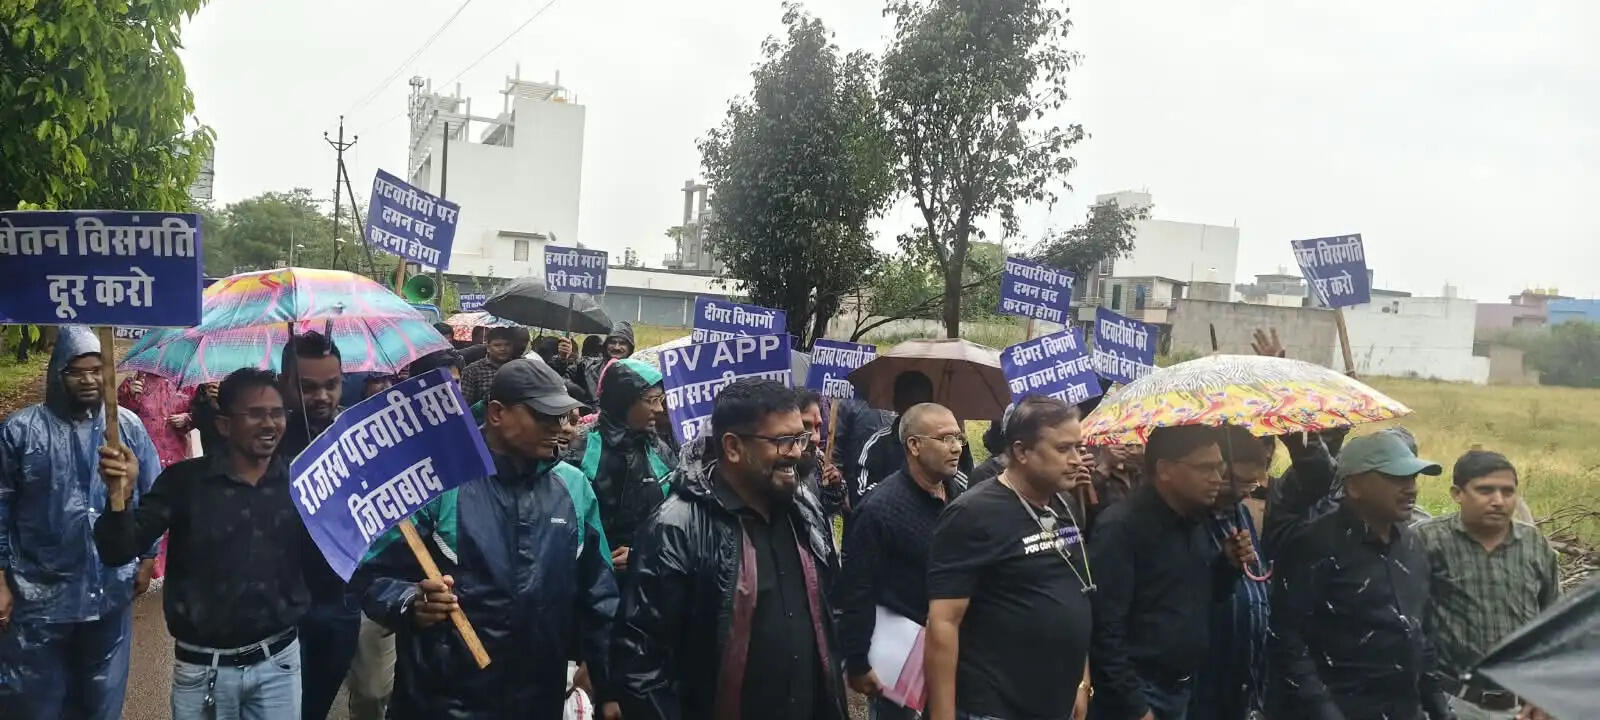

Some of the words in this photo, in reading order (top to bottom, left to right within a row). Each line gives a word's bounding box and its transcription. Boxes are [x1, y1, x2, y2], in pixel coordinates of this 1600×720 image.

[375, 177, 437, 217] पटवारीयों
[437, 204, 457, 224] पर
[75, 216, 197, 257] विसंगति
[382, 205, 414, 232] दमन
[415, 218, 436, 240] बंद
[371, 225, 408, 254] करना
[408, 238, 441, 265] होगा
[545, 250, 579, 267] हमारी
[1317, 236, 1363, 266] विसंगति
[548, 270, 567, 290] पूरी
[569, 272, 594, 289] करो
[1006, 261, 1059, 285] पटवारीयों
[1059, 274, 1074, 289] पर
[1328, 270, 1354, 296] करो
[46, 275, 88, 319] दूर
[93, 267, 155, 307] करो
[1013, 281, 1040, 299] दमन
[1041, 286, 1059, 303] बंद
[704, 302, 732, 325] दीगर
[733, 306, 775, 329] विभागों
[1003, 297, 1035, 316] करना
[1035, 302, 1063, 322] होगा
[1010, 343, 1043, 367] दीगर
[1041, 328, 1077, 358] विभागों
[1100, 318, 1136, 348] पटवारीयों
[1136, 326, 1149, 351] को
[664, 347, 701, 377] PV
[712, 335, 780, 368] APP
[812, 346, 836, 366] राजस्व
[836, 346, 863, 368] पटवारी
[1120, 351, 1135, 379] देना
[1009, 377, 1029, 394] का
[1028, 367, 1056, 388] काम
[1055, 358, 1077, 380] लेना
[1077, 352, 1093, 373] बंद
[665, 386, 684, 410] का
[293, 440, 350, 516] राजस्व
[338, 389, 423, 467] पटवारी
[413, 378, 464, 426] संघ
[347, 456, 443, 544] जिंदाबाद
[1024, 543, 1040, 555] YOU
